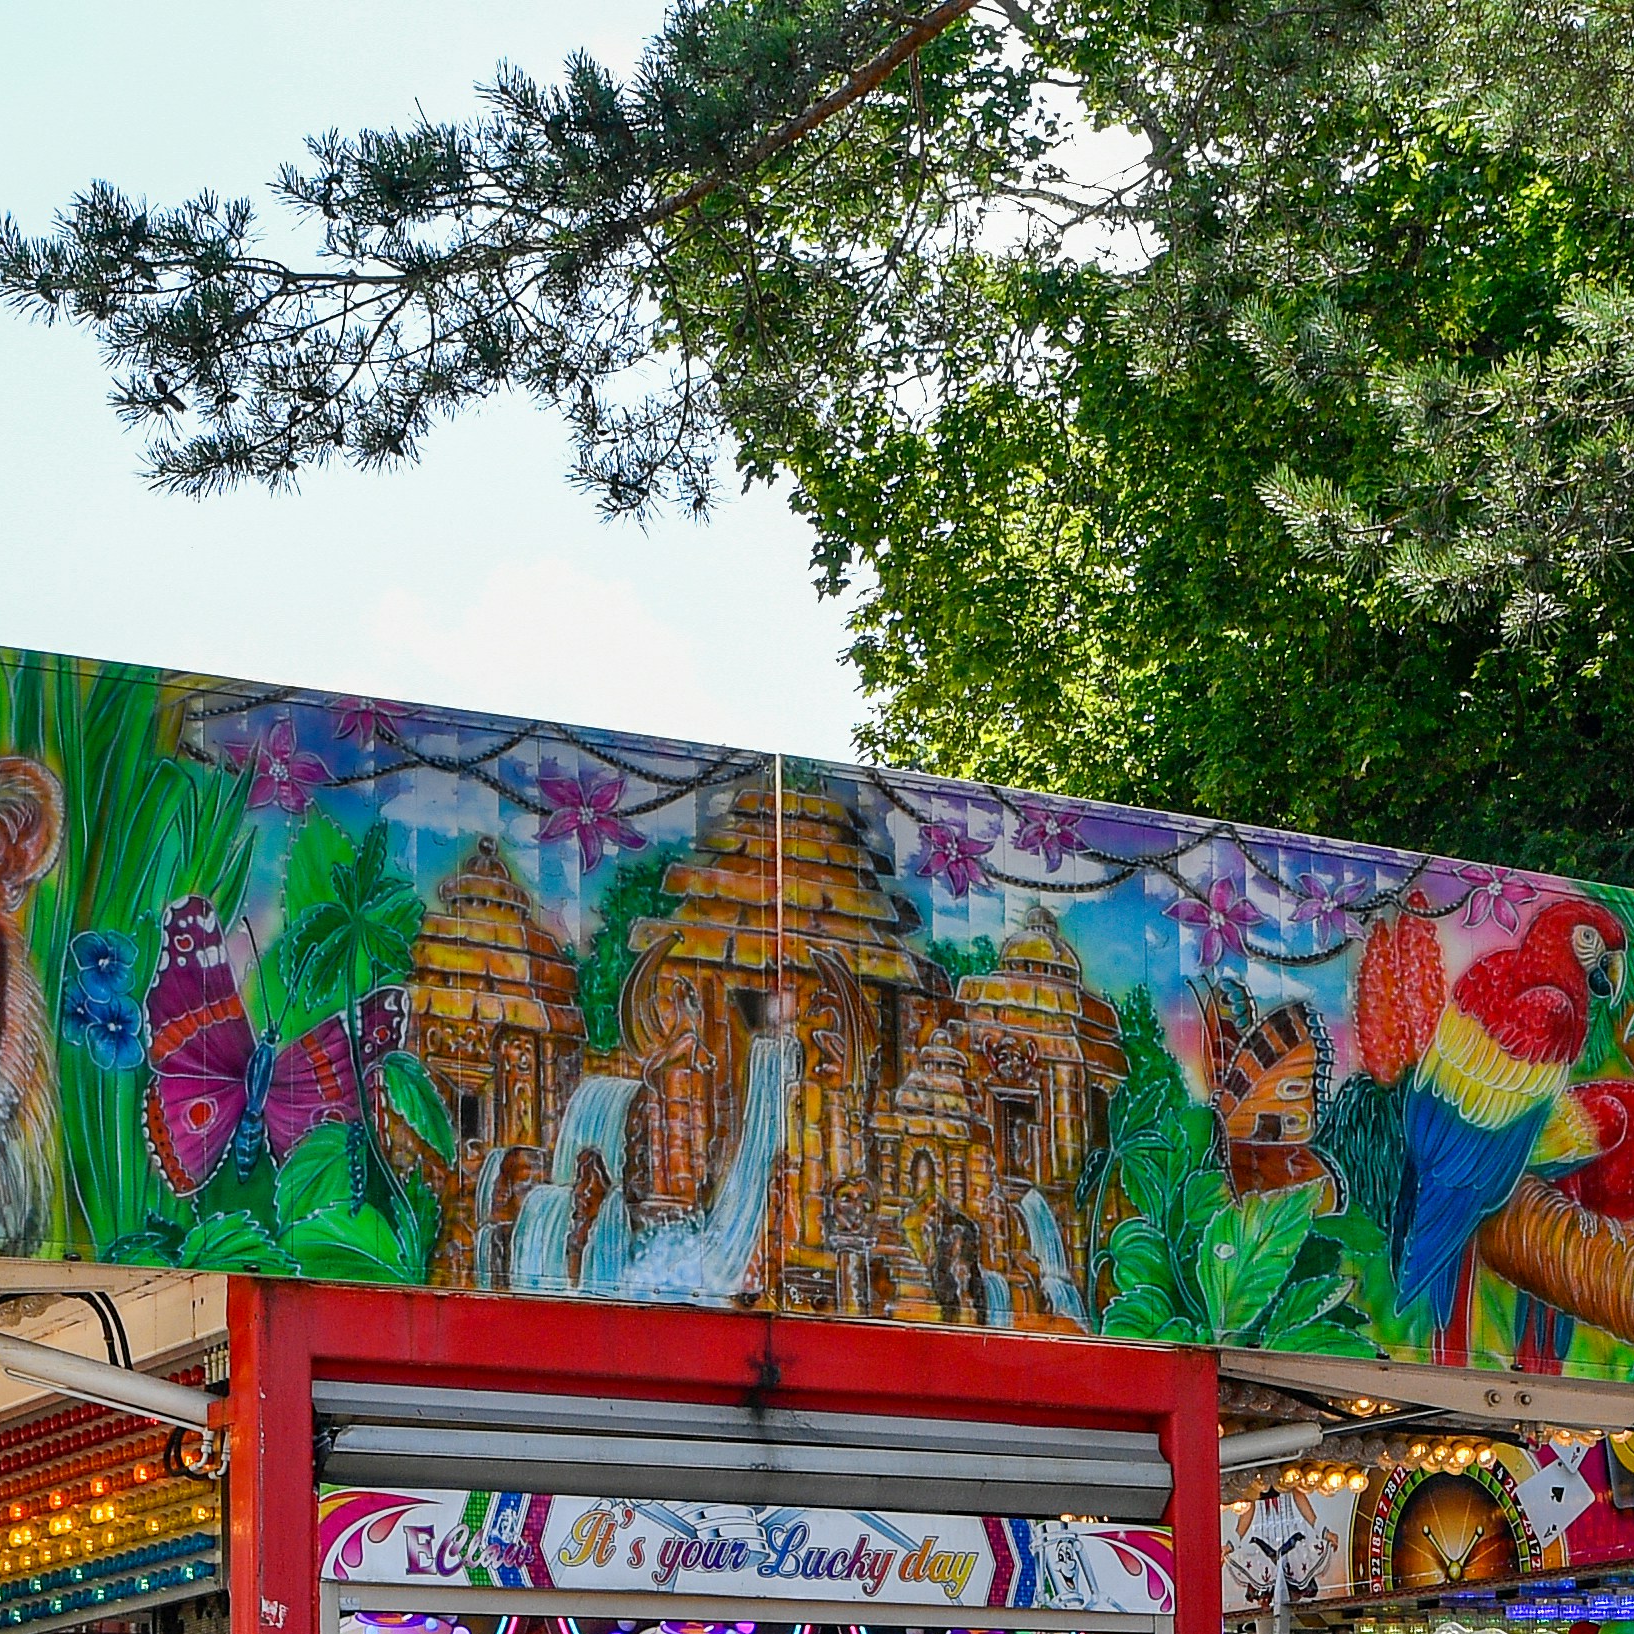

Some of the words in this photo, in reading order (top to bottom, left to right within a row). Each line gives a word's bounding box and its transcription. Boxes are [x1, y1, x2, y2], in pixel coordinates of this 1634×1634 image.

[561, 1508, 646, 1569] It's
[658, 1534, 749, 1585] your
[759, 1523, 892, 1596] Lucky
[899, 1538, 980, 1598] day
